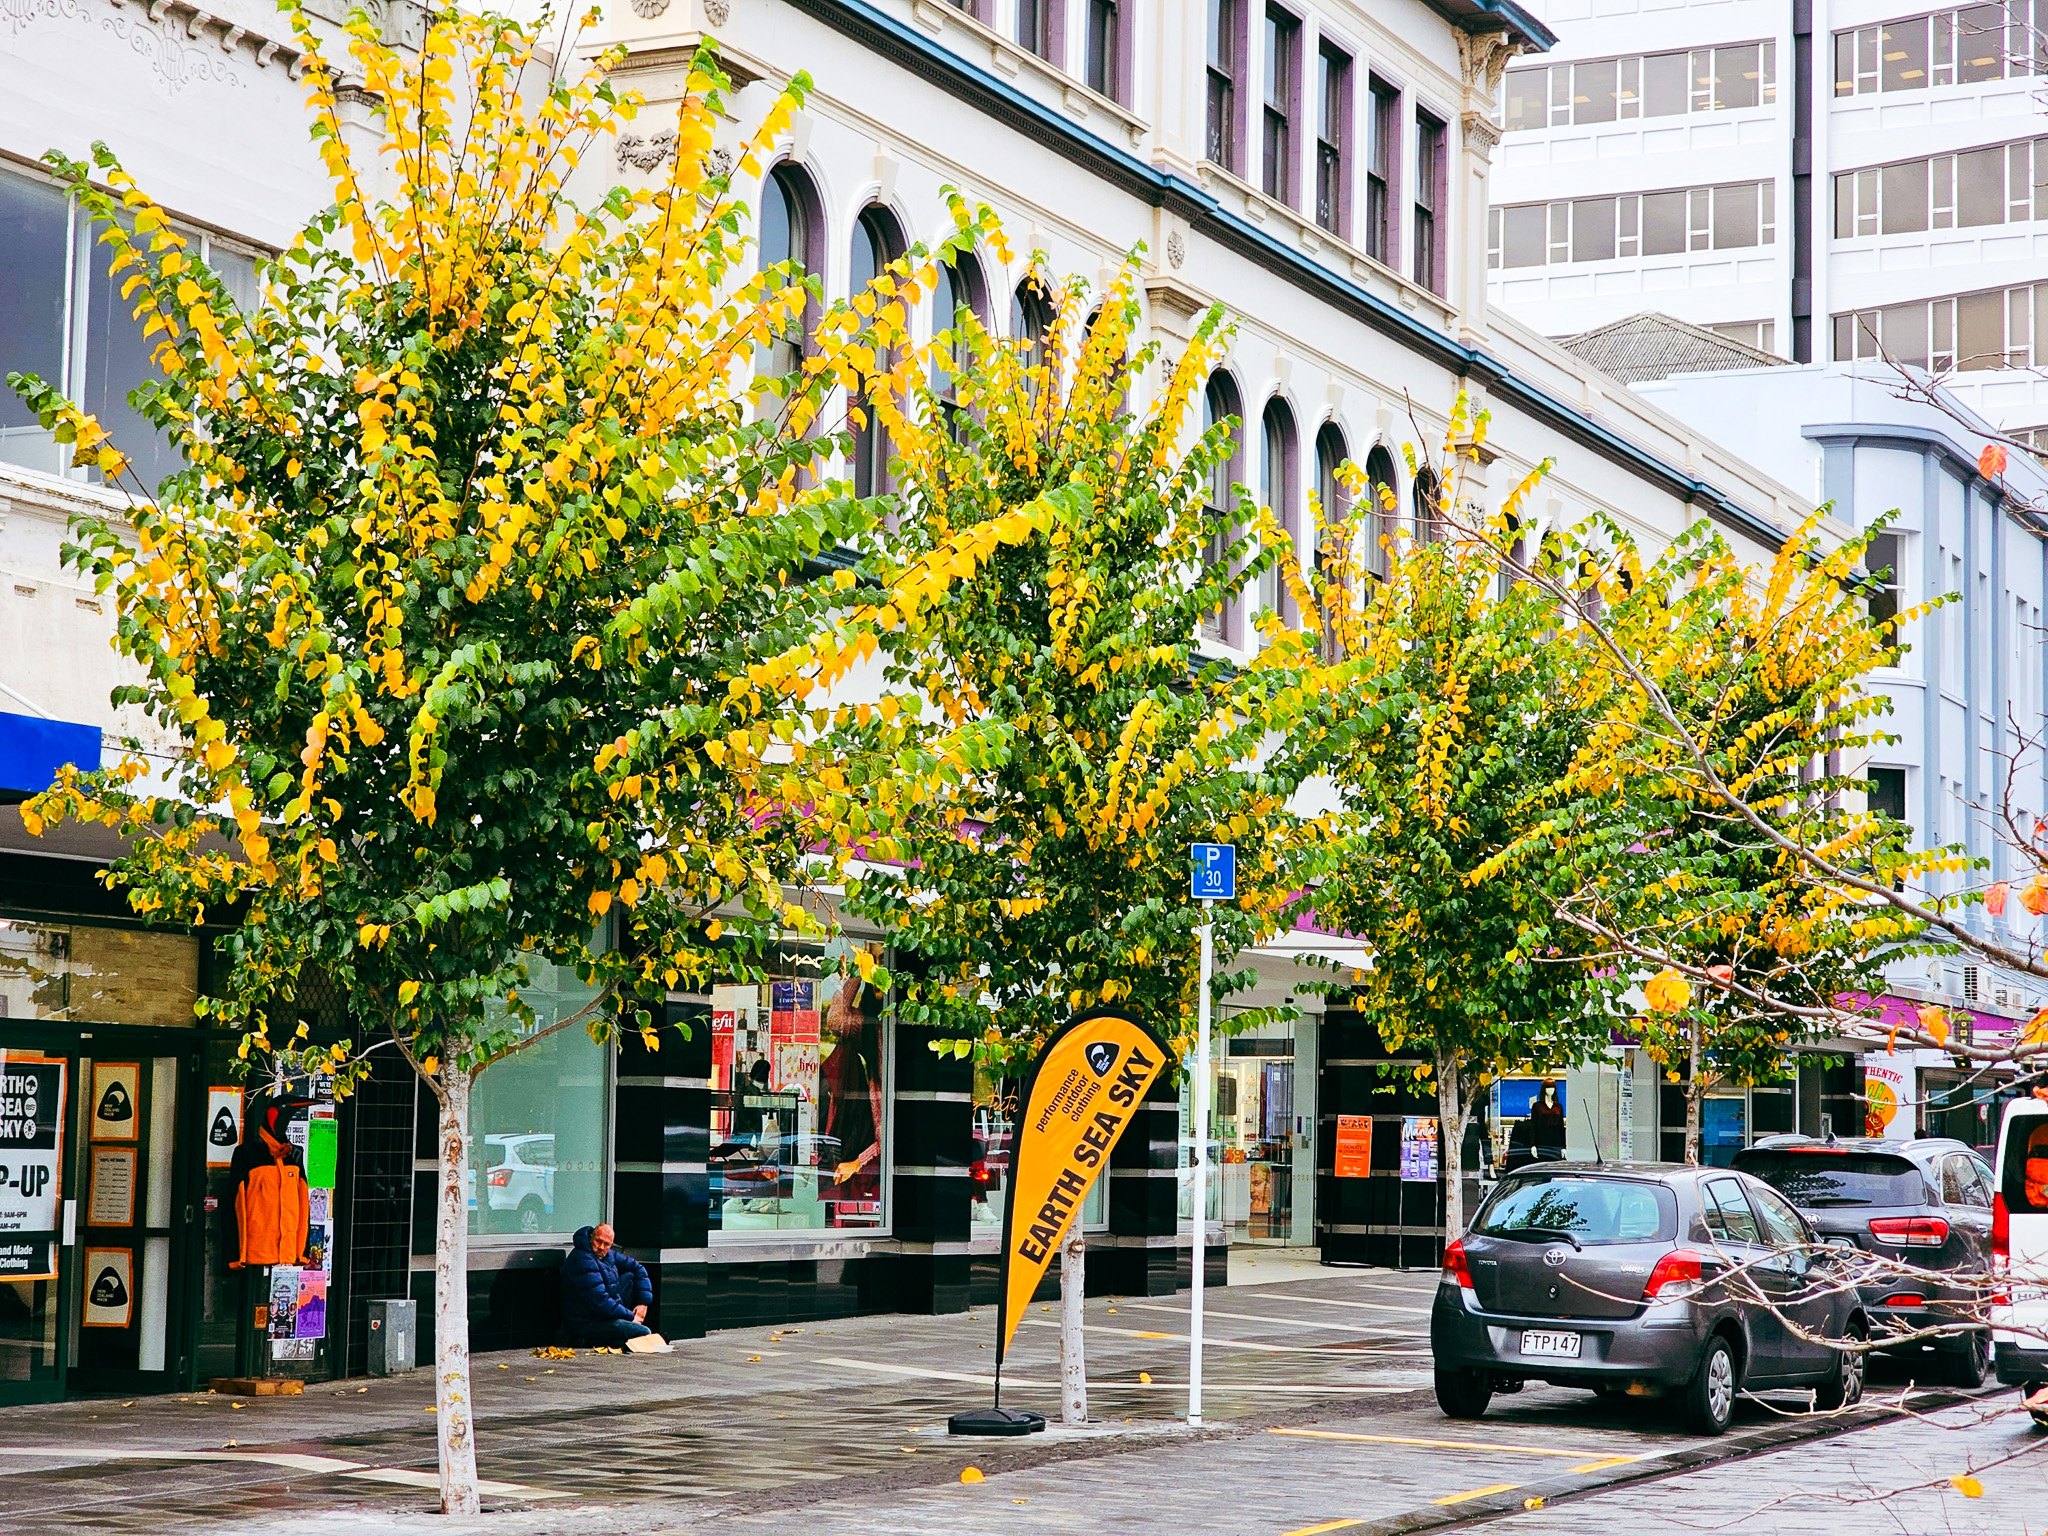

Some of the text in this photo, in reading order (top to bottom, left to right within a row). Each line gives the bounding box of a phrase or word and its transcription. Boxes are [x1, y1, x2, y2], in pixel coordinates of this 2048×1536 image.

[1207, 847, 1220, 868] P
[1206, 870, 1221, 887] 30
[1035, 1069, 1079, 1133] performance
[1062, 1075, 1089, 1115] outdoor
[1071, 1082, 1102, 1122] clothing
[1018, 1046, 1155, 1266] EARTH SEA SKY
[13, 1244, 34, 1256] Made
[1523, 1334, 1579, 1352] FTP147
